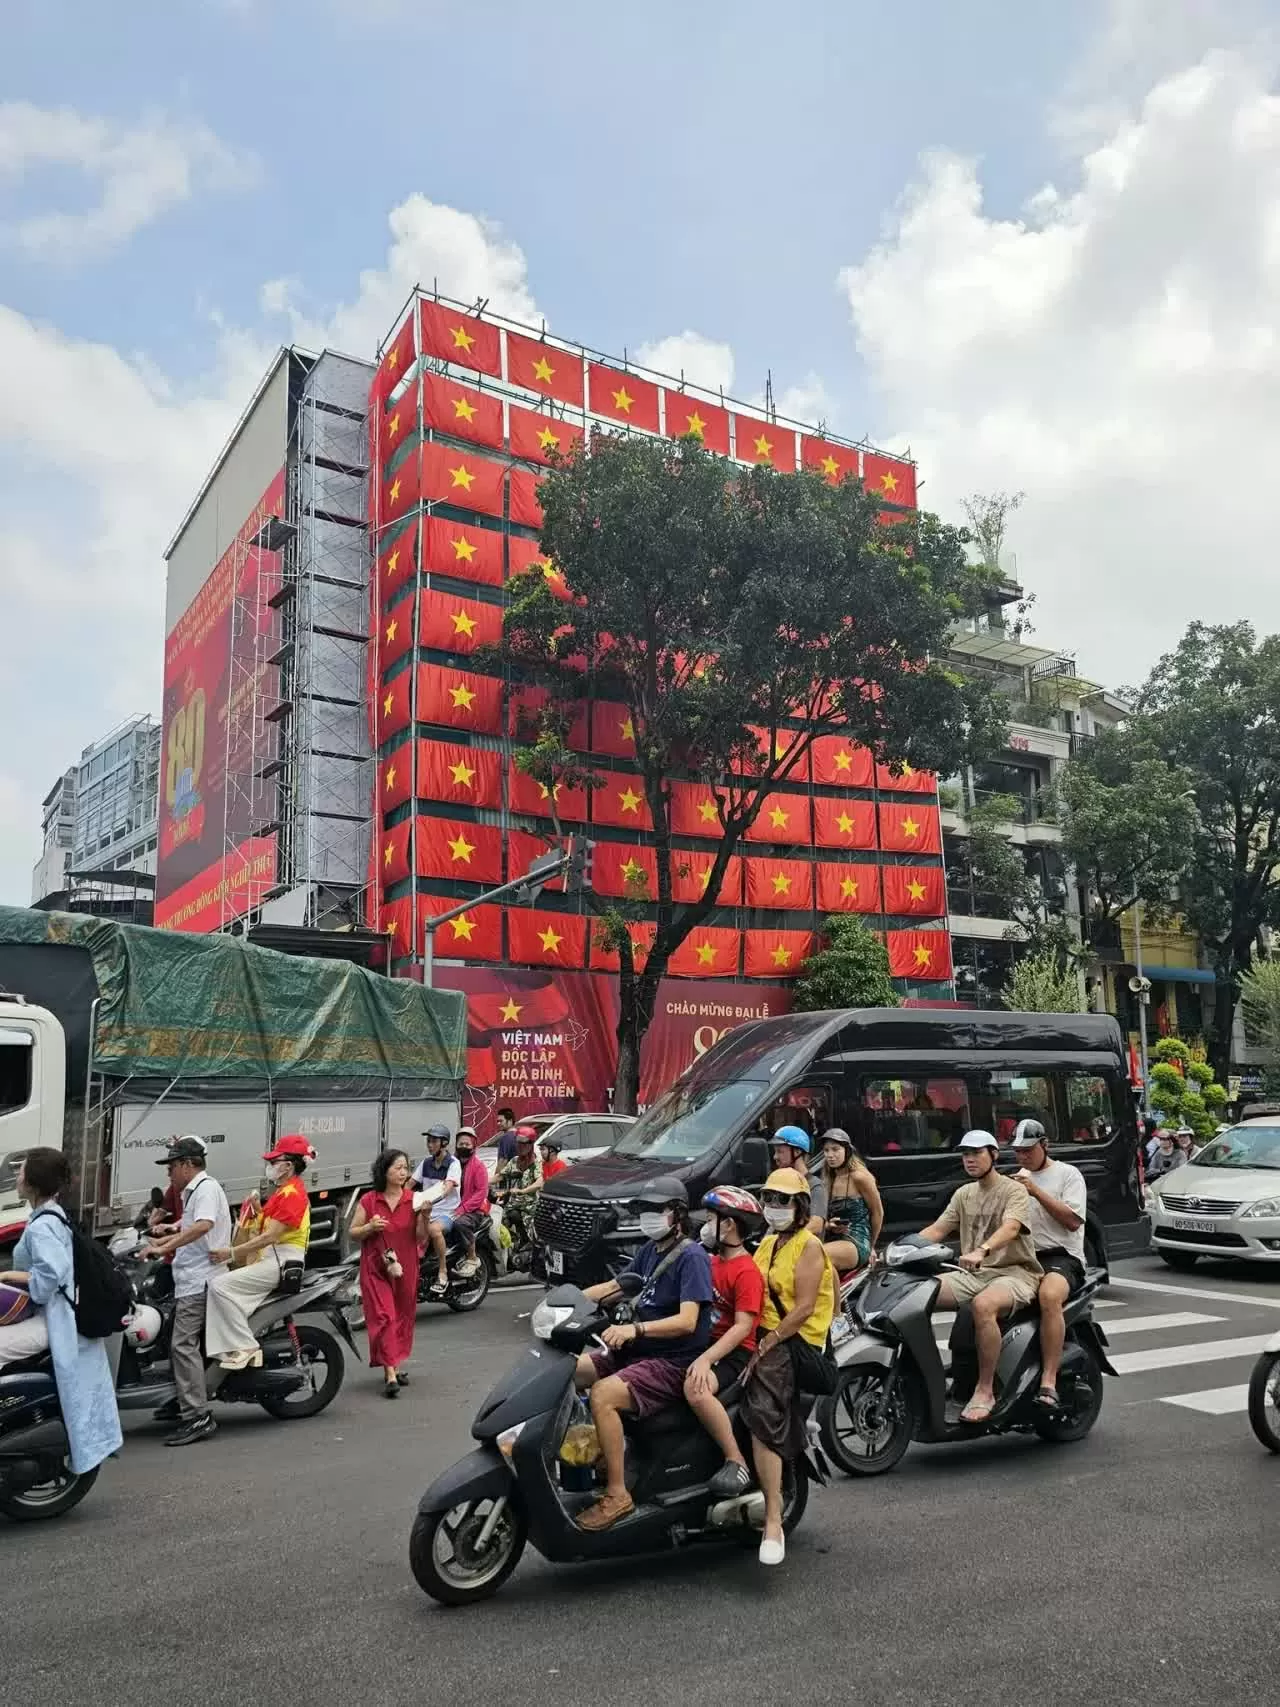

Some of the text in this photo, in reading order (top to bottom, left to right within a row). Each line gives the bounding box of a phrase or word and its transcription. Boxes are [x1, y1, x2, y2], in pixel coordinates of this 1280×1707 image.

[666, 1000, 697, 1016] CHÀO
[699, 1001, 733, 1017] MỪNG
[735, 1005, 754, 1021] ĐẠI
[502, 1029, 563, 1049] VIỆT NAM
[501, 1048, 557, 1066] ĐỘC LẬP
[501, 1065, 528, 1081] HOÀ
[499, 1080, 575, 1098] PHÁT TRIỂN
